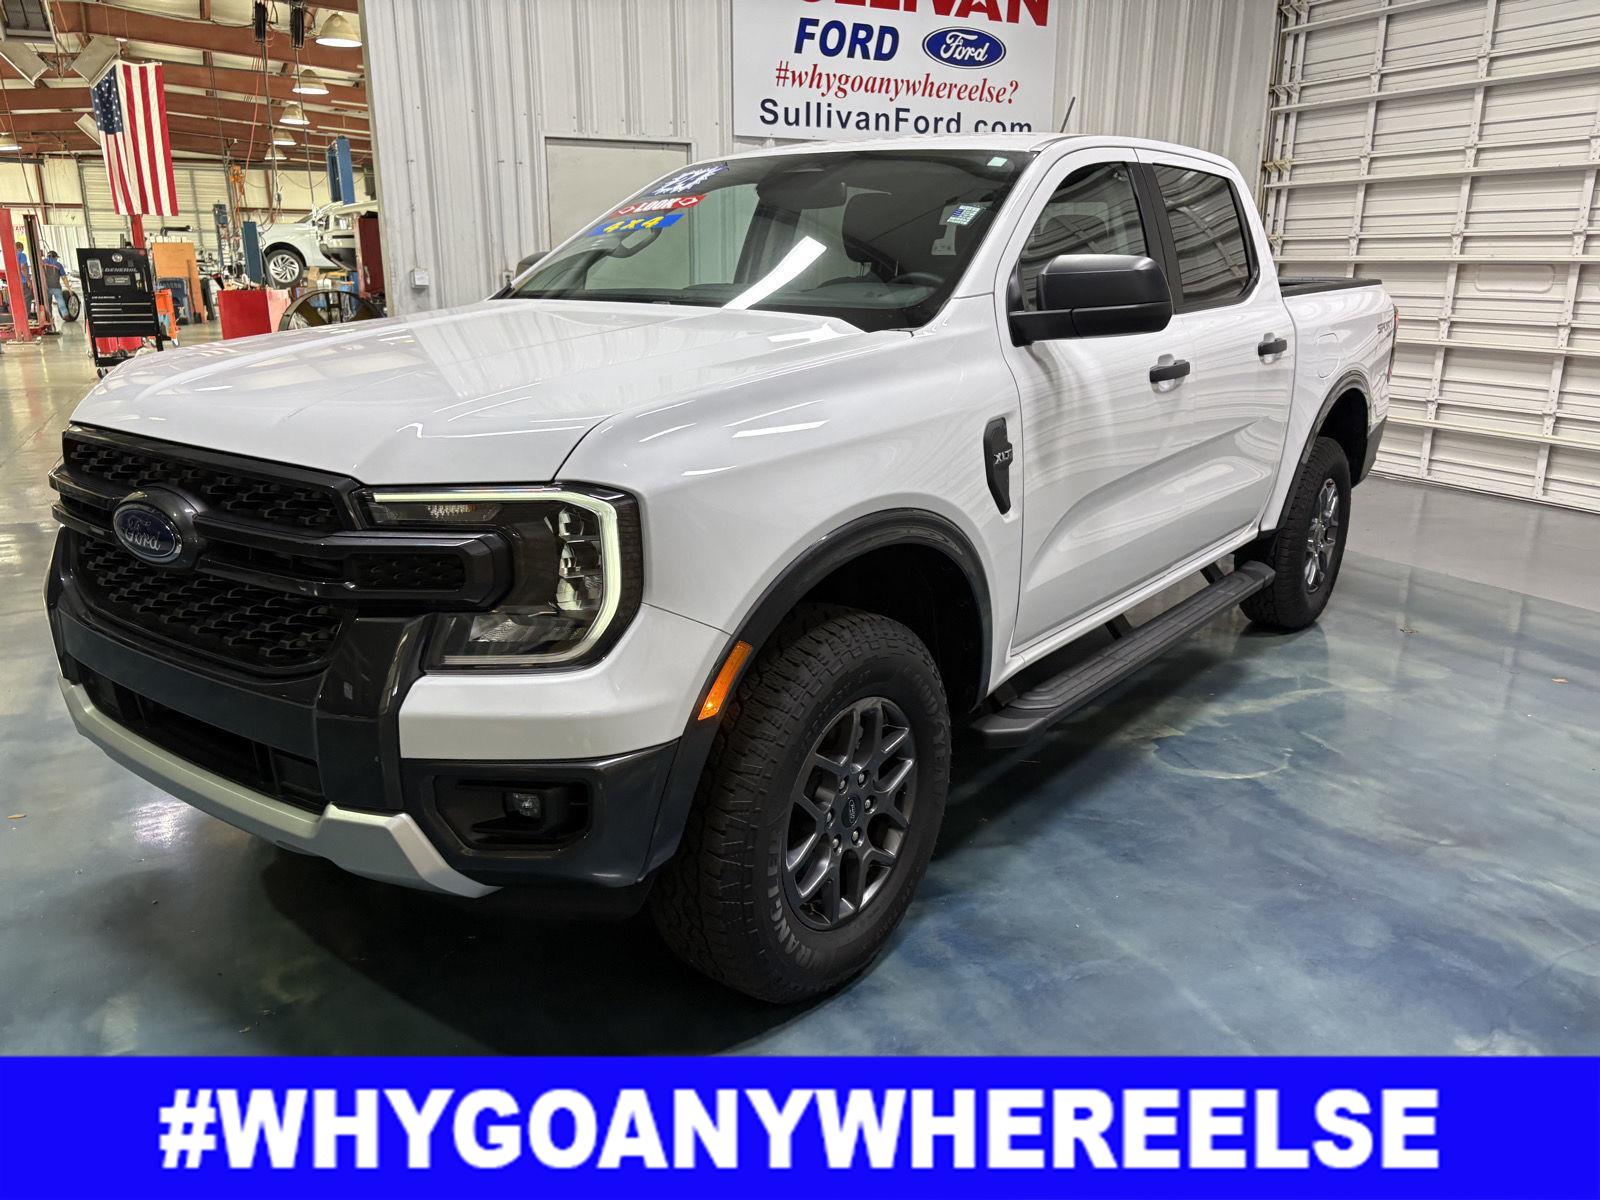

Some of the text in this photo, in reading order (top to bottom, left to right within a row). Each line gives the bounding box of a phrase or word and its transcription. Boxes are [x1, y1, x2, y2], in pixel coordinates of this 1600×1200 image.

[794, 17, 899, 61] FORD
[939, 32, 989, 62] Ford
[775, 60, 1018, 104] #whygoanywhereelse?
[759, 98, 1032, 133] SullivanFordcom
[993, 448, 1012, 465] XLT
[123, 515, 162, 551] Ford
